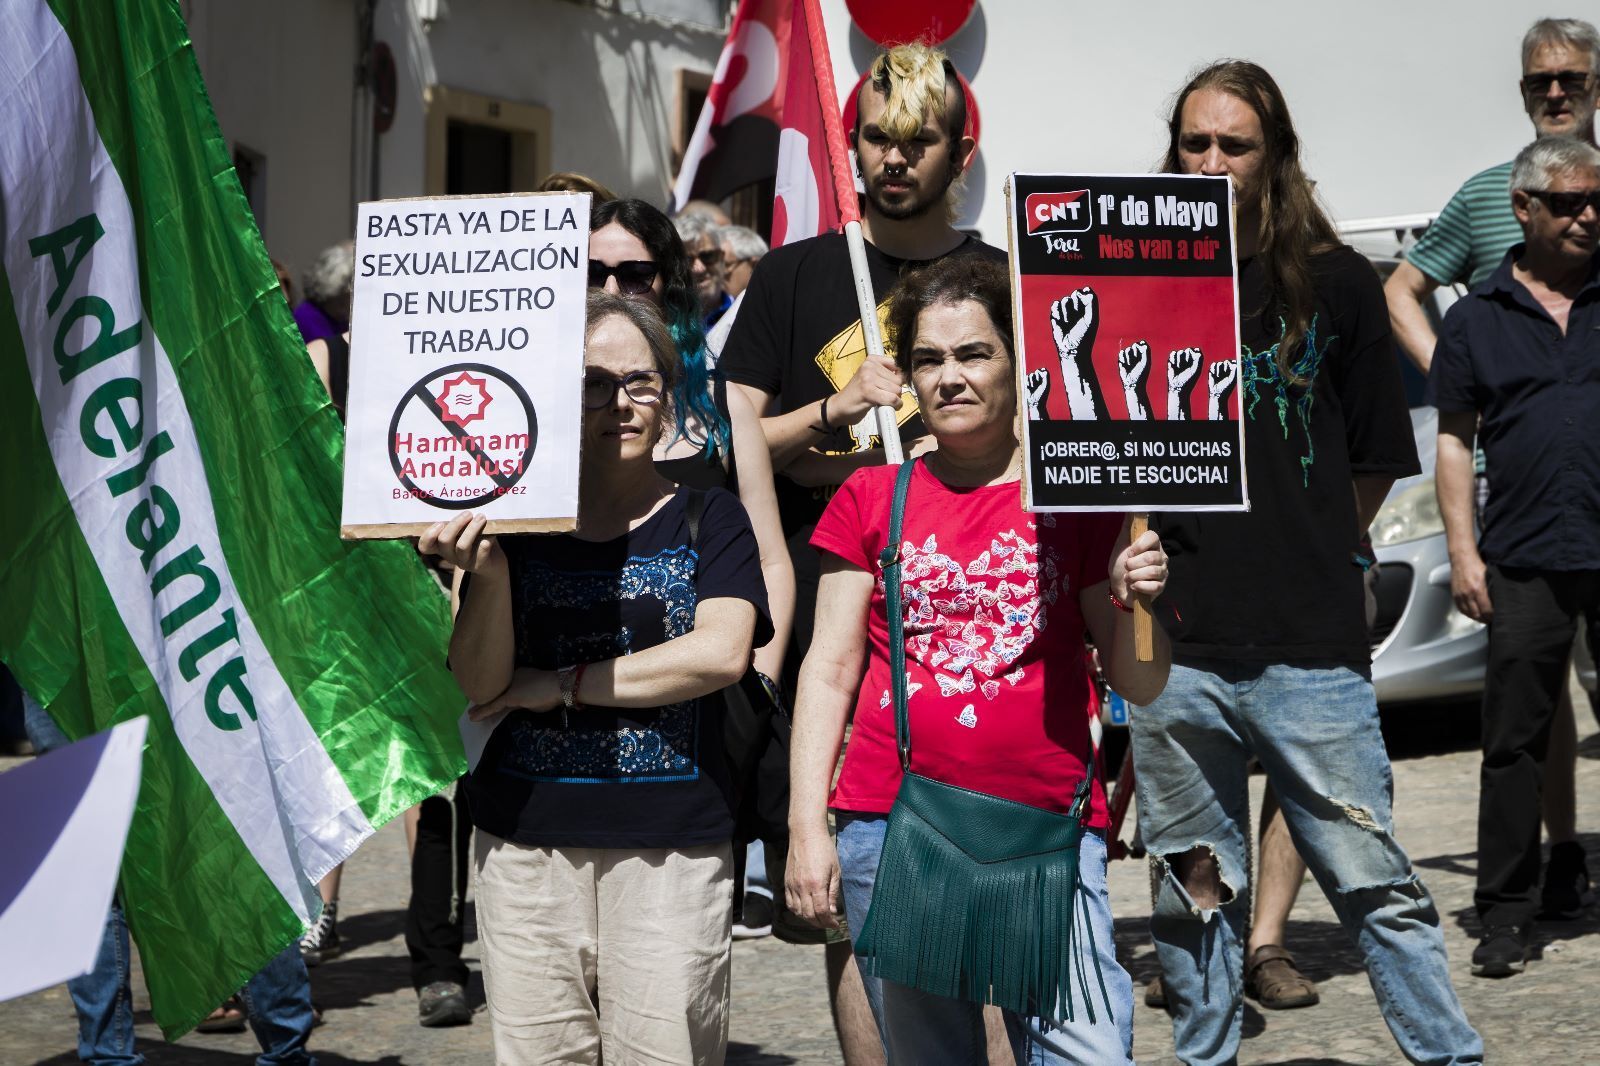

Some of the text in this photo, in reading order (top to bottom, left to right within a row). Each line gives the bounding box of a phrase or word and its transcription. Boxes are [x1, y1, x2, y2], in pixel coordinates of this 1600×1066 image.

[368, 208, 577, 237] BASTA YA DE LA
[1035, 202, 1081, 222] CNT
[1121, 195, 1149, 225] de
[1155, 196, 1217, 231] Mayo
[361, 243, 578, 277] SEXUALIZACIÓN
[1099, 235, 1134, 259] Nos
[1139, 240, 1172, 259] van
[1178, 240, 1188, 259] a
[1194, 237, 1219, 260] oír
[383, 287, 554, 315] DE NUESTRO
[404, 327, 528, 354] TRABAJO
[395, 432, 530, 454] Hammam
[1041, 442, 1231, 460] ¡OBRER@, SI NO LUCHAS
[28, 212, 258, 732] Adelante
[399, 451, 524, 479] Andalusí
[1045, 466, 1227, 484] NADIE TE ESCUCHA!
[392, 484, 527, 500] Baños Árabes Jerez
